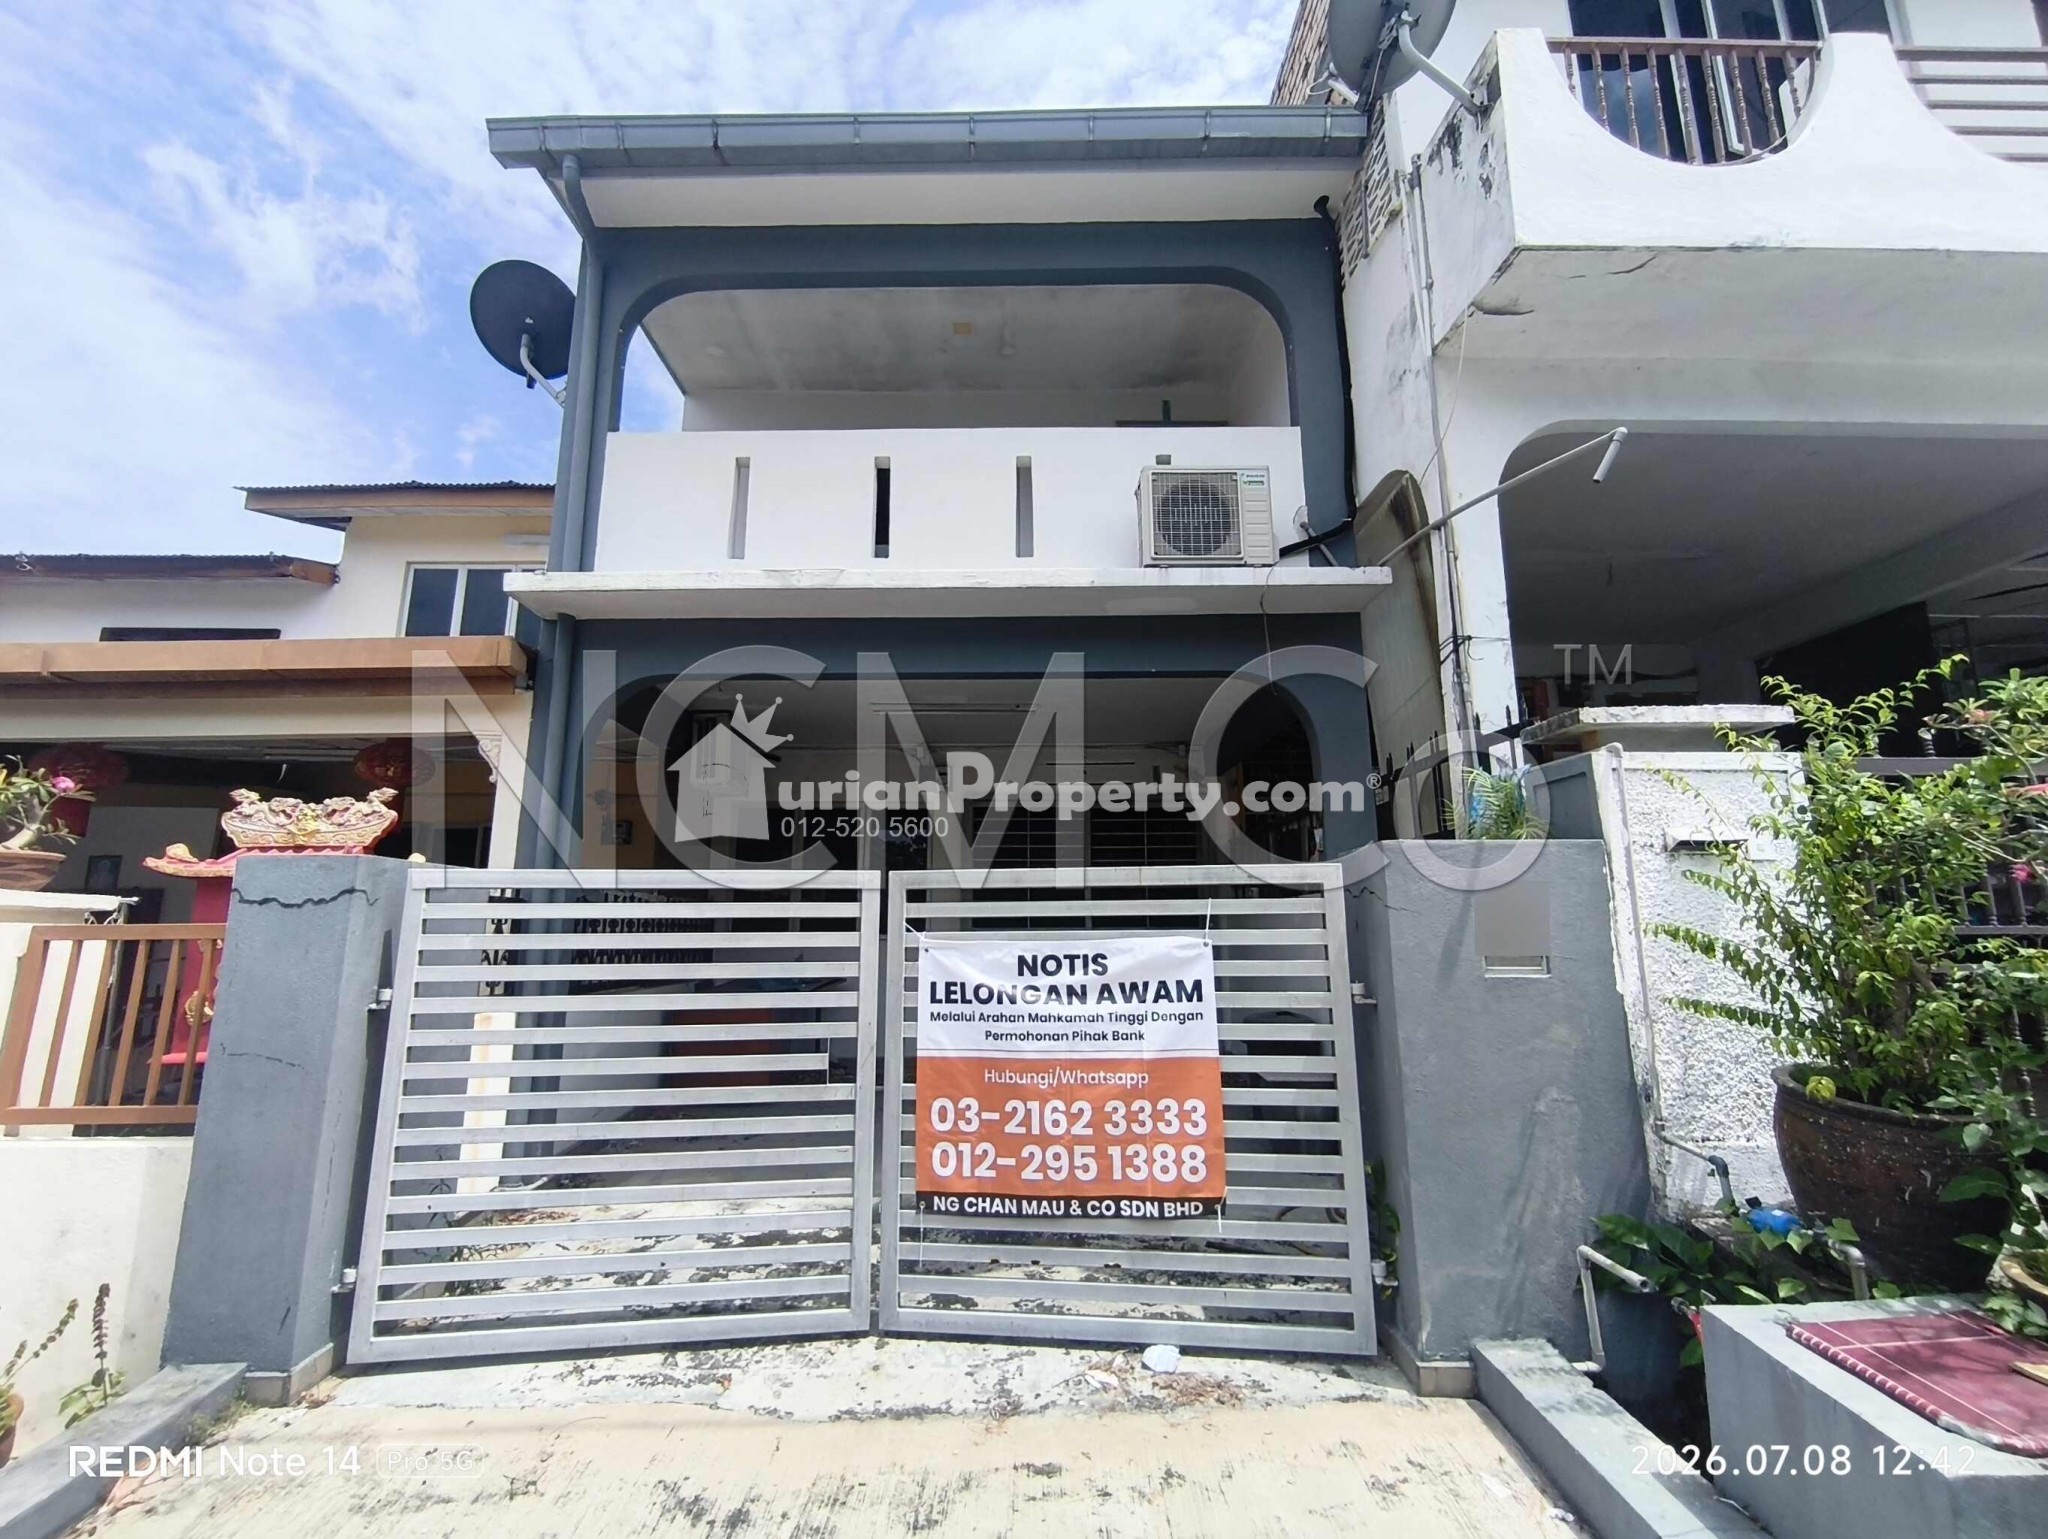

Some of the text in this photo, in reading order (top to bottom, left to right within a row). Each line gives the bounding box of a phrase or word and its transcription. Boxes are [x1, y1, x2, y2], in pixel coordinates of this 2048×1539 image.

[1017, 953, 1108, 977] NOTIS
[930, 979, 1203, 1005] LELONGAN AWAM
[930, 1011, 1203, 1026] Melalui Arahan Mahkamah Tinggi Dengan
[985, 1030, 1145, 1042] Permohonan Pihak Bank
[984, 1067, 1149, 1089] Hubungi/Whatsapp
[930, 1097, 1207, 1137] 03-2162 3333
[931, 1142, 1207, 1183] 012-295 1388
[933, 1196, 1203, 1217] NG CHAN MAU & CO SDN BHD
